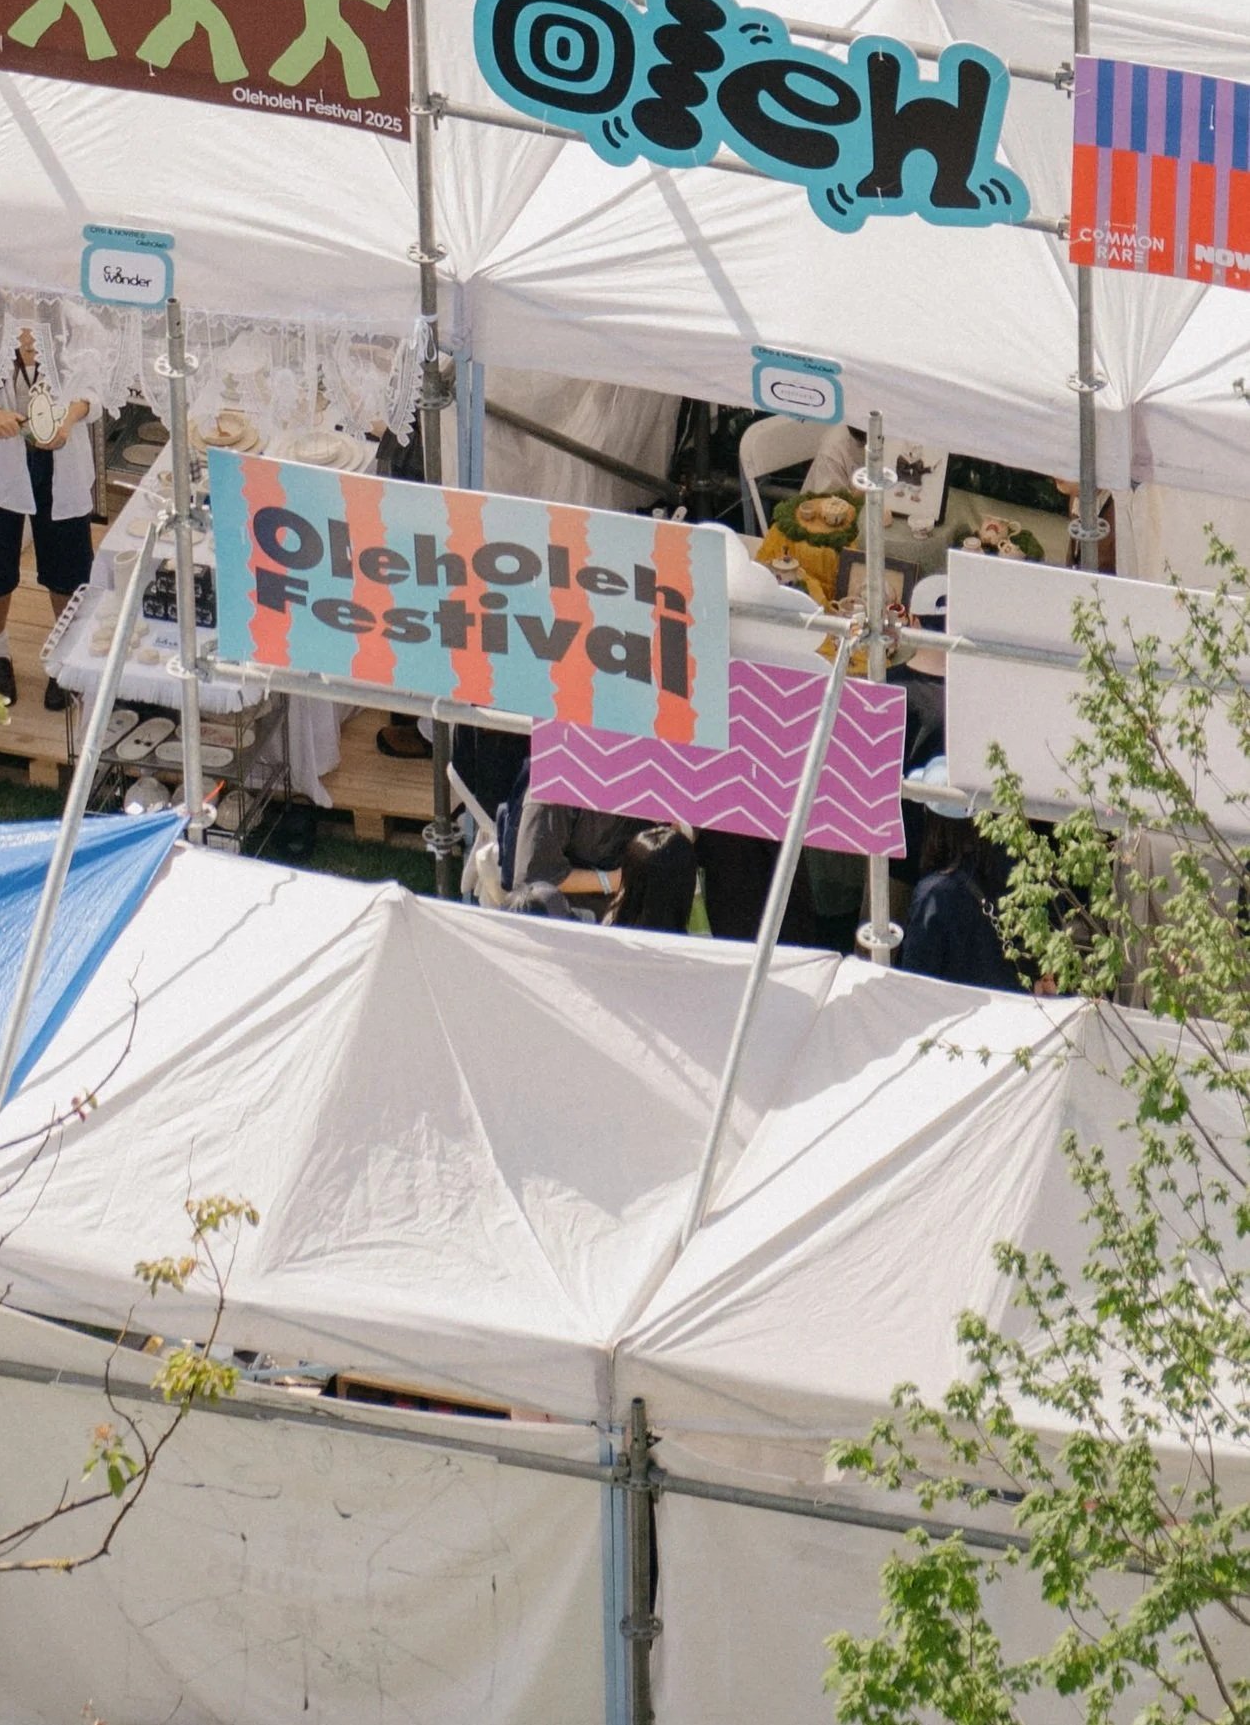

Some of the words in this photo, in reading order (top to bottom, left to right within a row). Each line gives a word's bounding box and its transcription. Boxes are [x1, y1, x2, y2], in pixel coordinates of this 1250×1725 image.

[232, 87, 302, 111] Oleholeh
[306, 99, 362, 123] Festival
[365, 111, 403, 133] 2025
[1079, 227, 1165, 253] COMMON
[1096, 245, 1146, 265] RARE
[103, 273, 152, 288] wonder
[253, 506, 687, 614] OlehOleh
[255, 566, 688, 699] Festival
